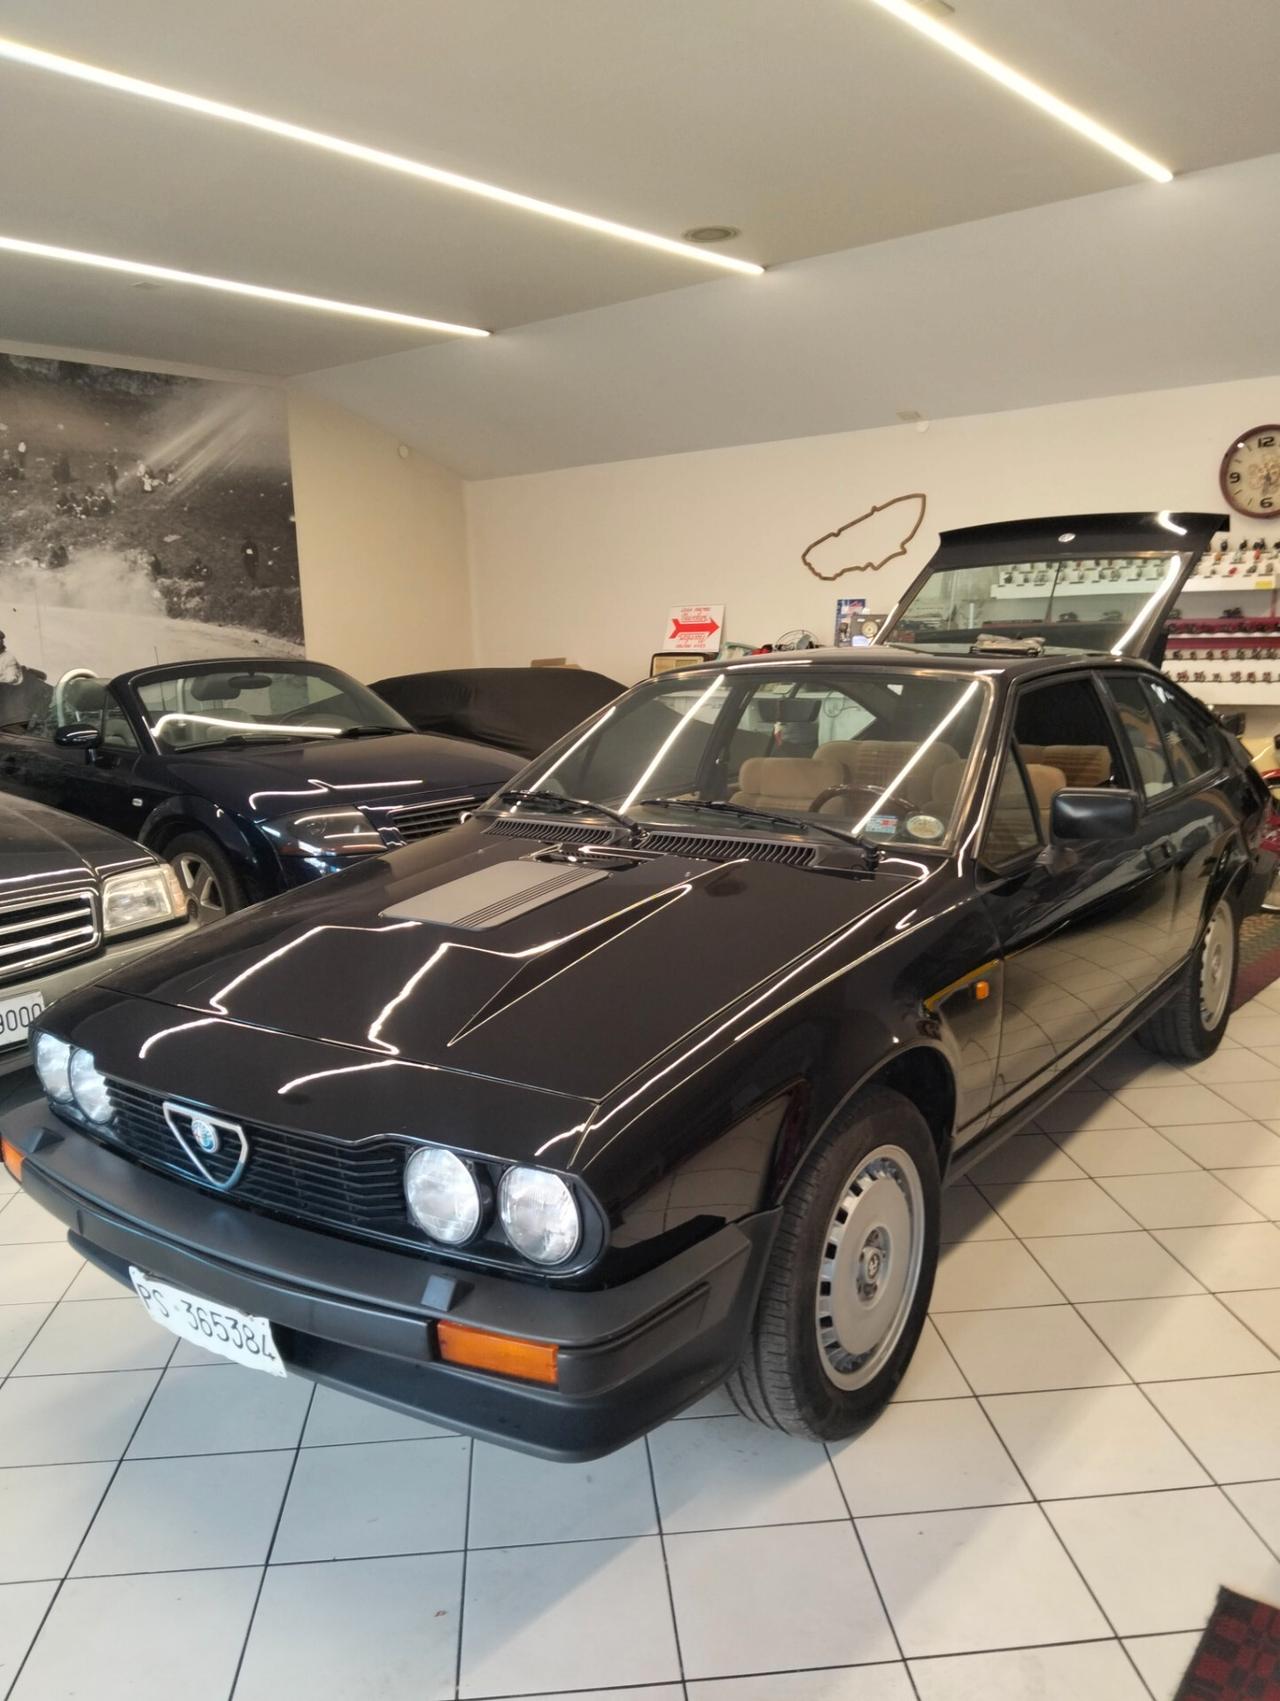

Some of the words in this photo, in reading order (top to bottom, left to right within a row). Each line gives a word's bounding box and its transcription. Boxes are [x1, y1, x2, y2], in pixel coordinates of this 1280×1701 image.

[1257, 436, 1275, 449] 12
[1229, 471, 1241, 484] 9
[1260, 497, 1273, 508] 6
